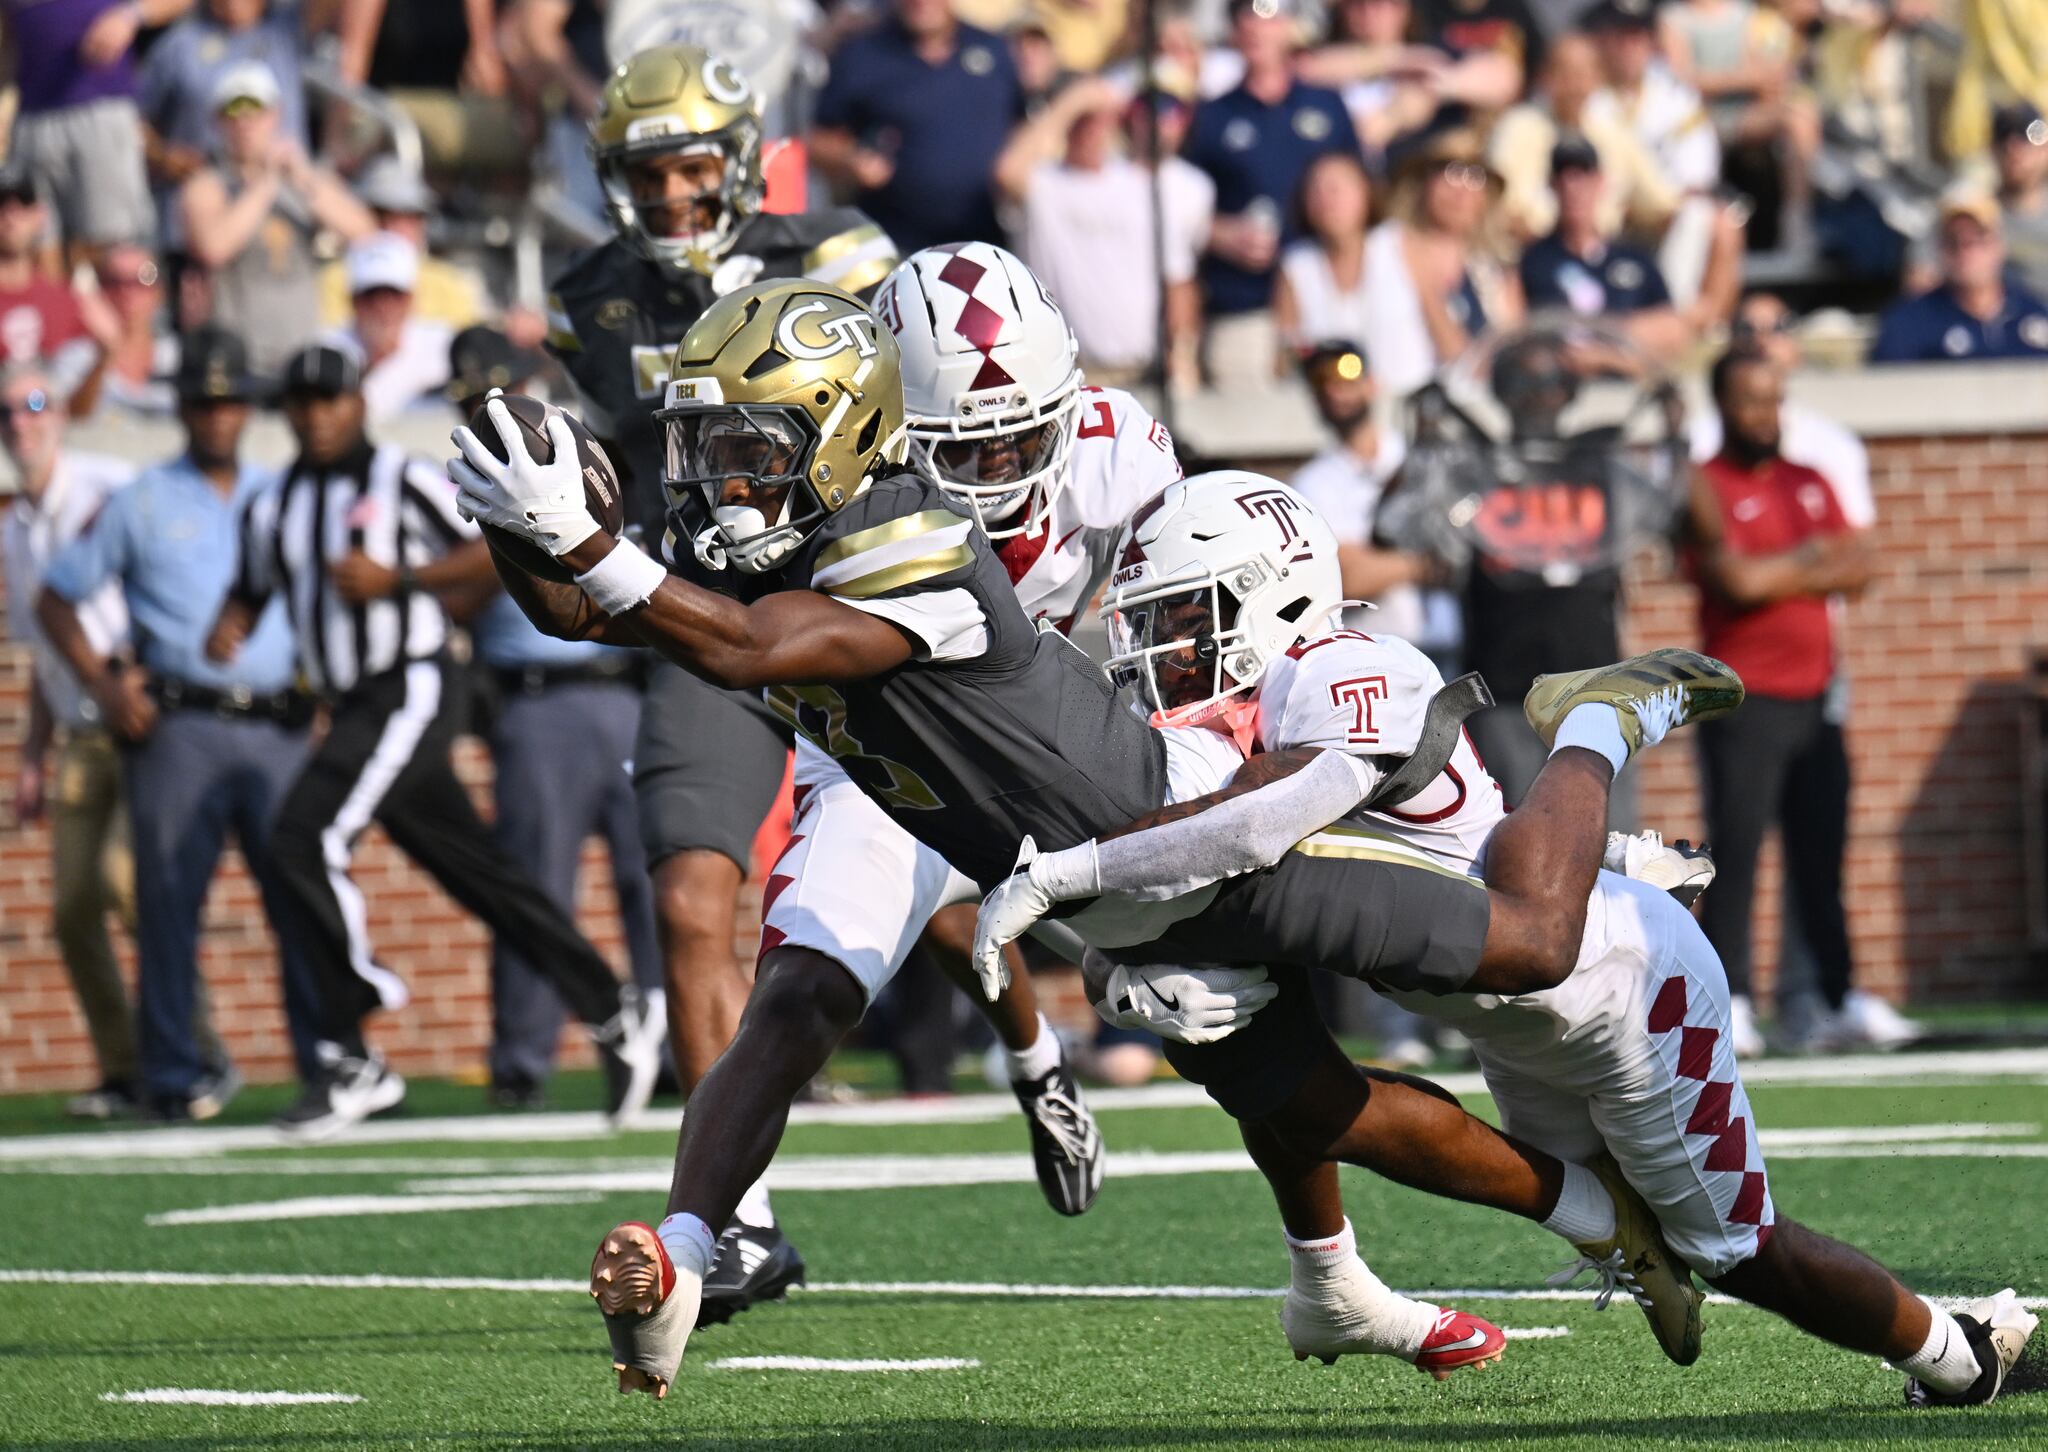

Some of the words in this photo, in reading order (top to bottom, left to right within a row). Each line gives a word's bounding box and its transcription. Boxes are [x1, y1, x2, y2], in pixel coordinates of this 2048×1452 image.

[777, 300, 878, 360] GT
[676, 383, 696, 399] TECH
[978, 396, 1007, 407] OWLS
[582, 465, 613, 508] DIME
[1233, 489, 1314, 564] T
[1112, 565, 1143, 588] OWLS
[1330, 675, 1389, 744] T
